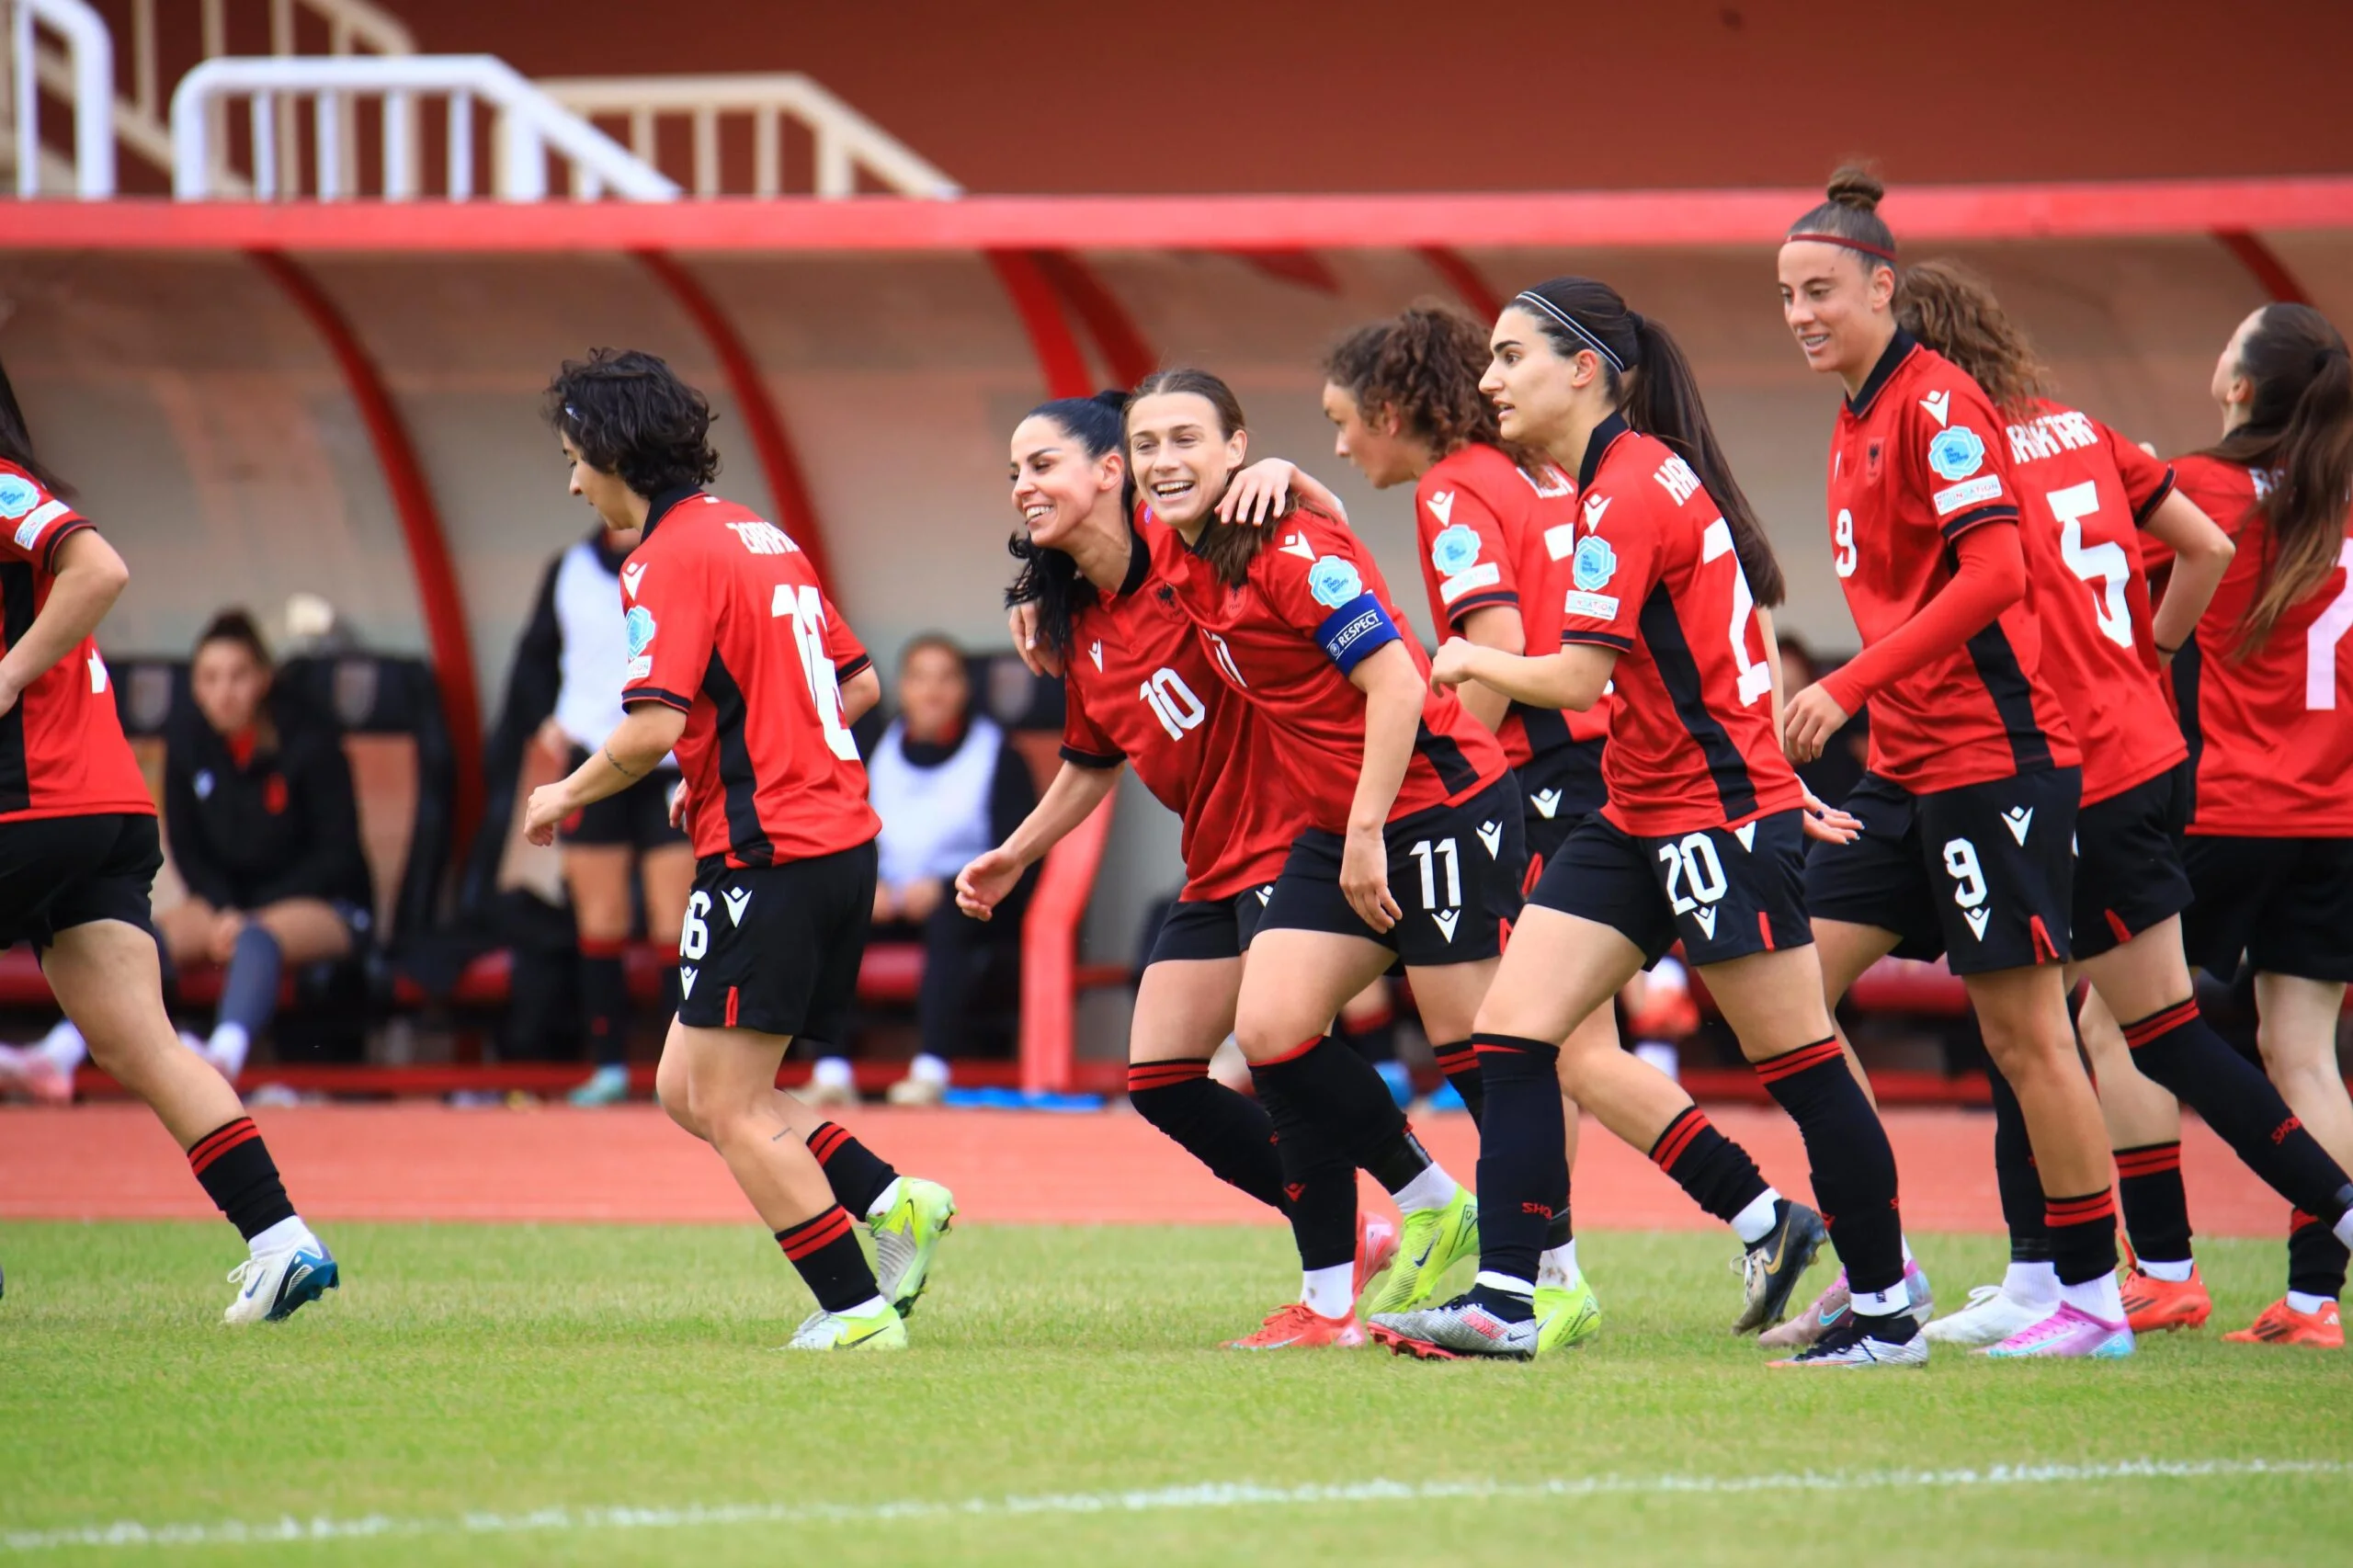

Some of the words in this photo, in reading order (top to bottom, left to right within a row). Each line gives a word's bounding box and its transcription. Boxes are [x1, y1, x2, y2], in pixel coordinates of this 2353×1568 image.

[1835, 508, 1858, 577] 9
[2046, 480, 2132, 648] 5
[1338, 612, 1380, 646] RESPECT
[1140, 667, 1206, 742] 10
[1409, 837, 1461, 910] 11
[1659, 832, 1728, 916] 20
[1943, 837, 1987, 908] 9
